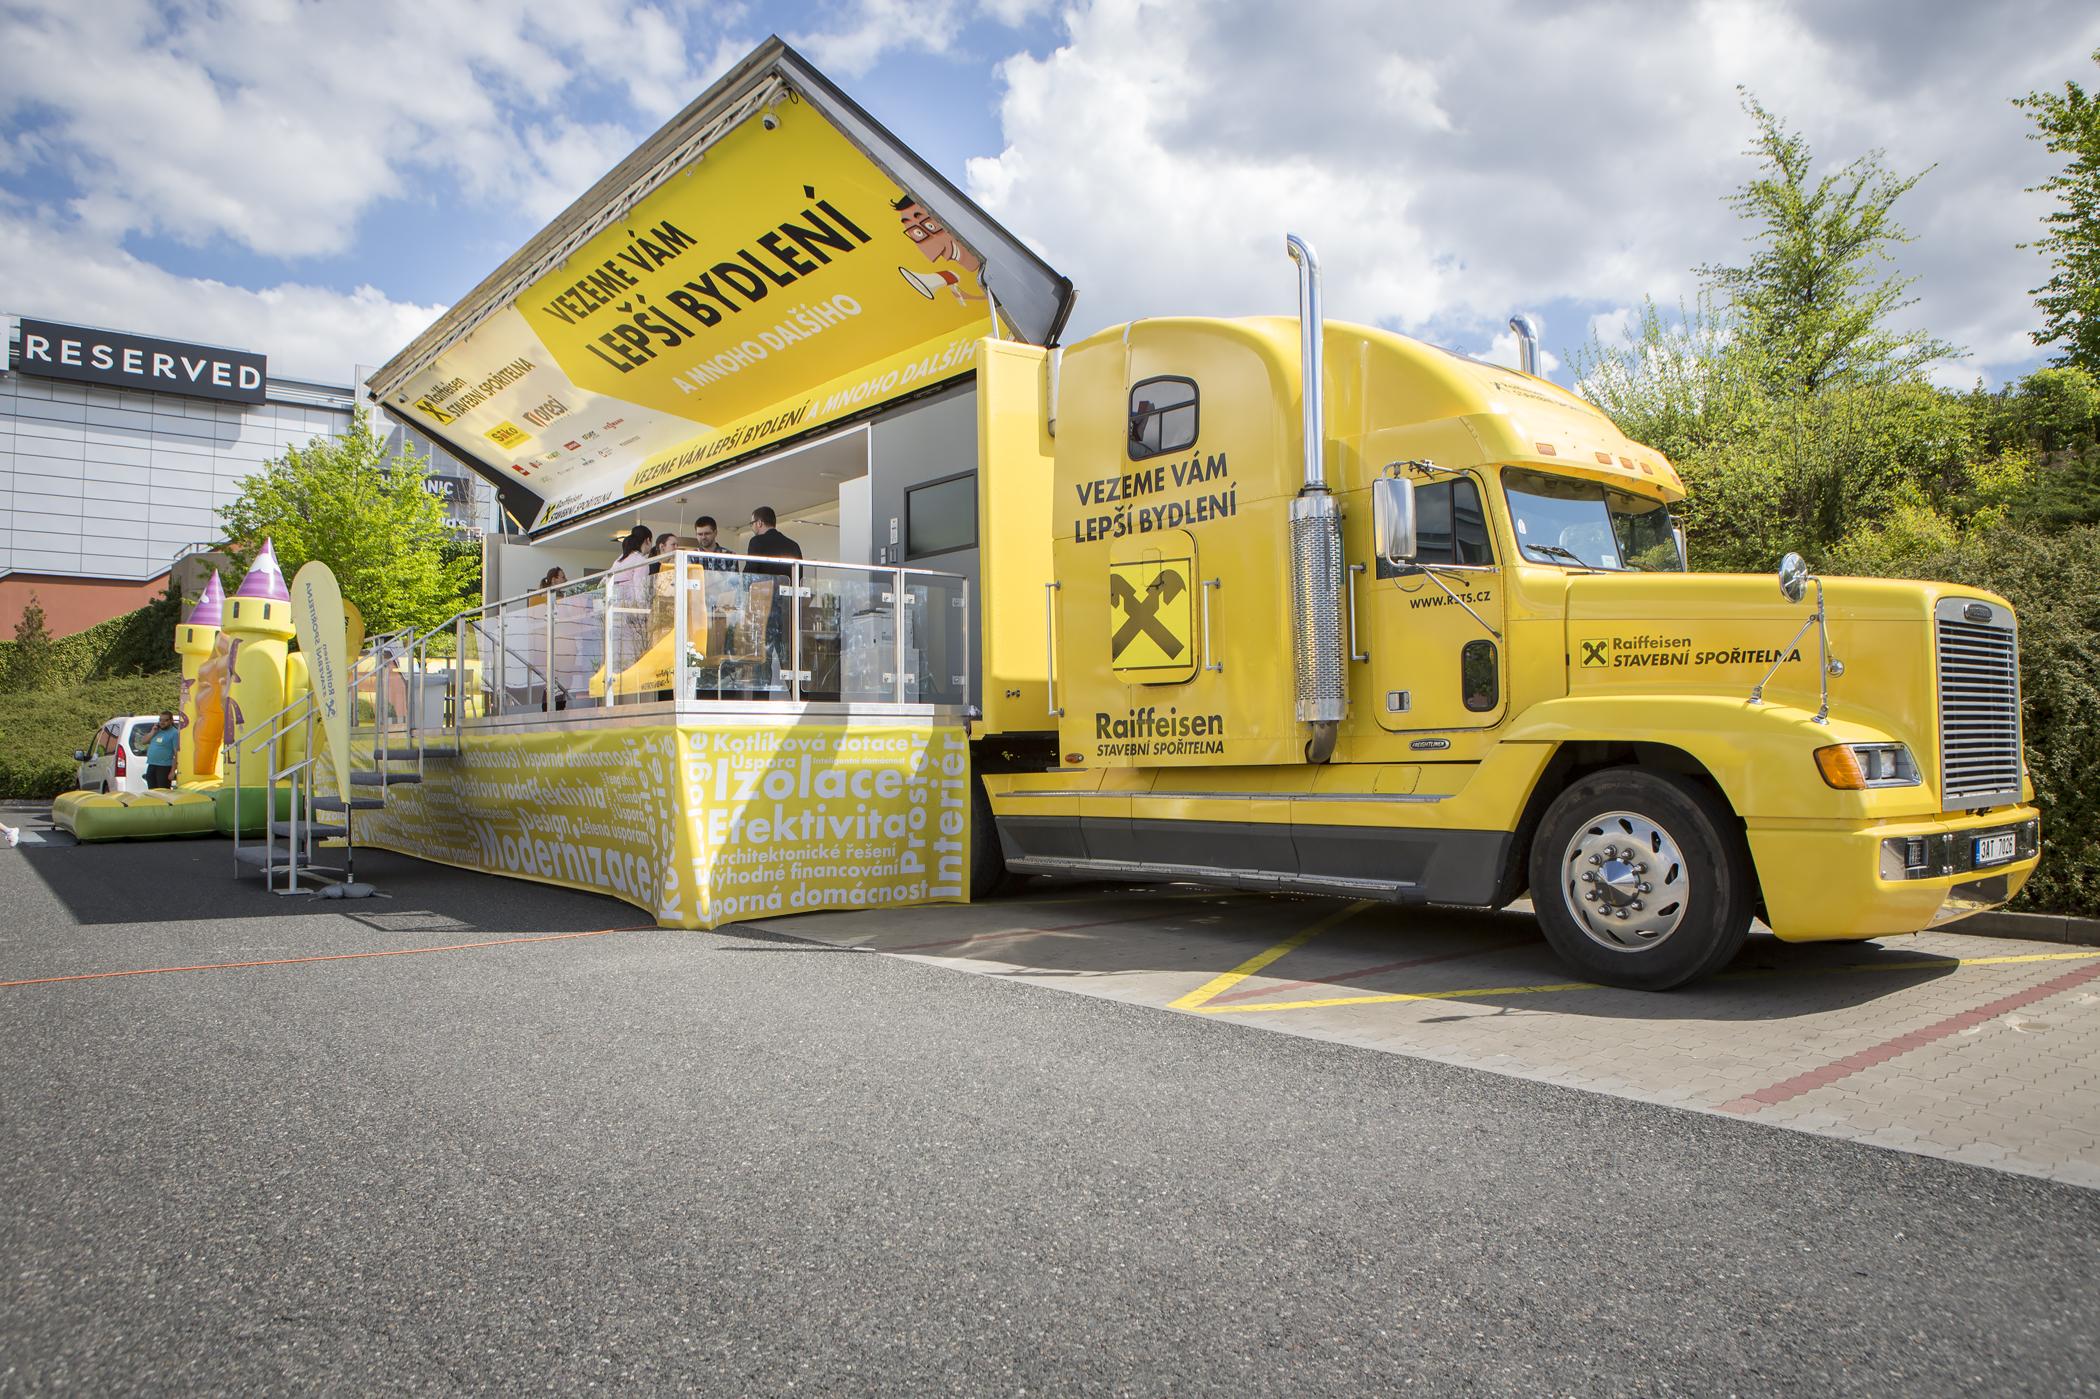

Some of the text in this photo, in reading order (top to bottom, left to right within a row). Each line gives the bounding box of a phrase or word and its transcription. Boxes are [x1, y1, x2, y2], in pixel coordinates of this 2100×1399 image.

[542, 220, 698, 325] VEZEME VÁM
[585, 182, 872, 374] LEPŠÍ BYDLENÍ
[26, 334, 261, 390] RESERVED
[672, 294, 862, 395] A MNOHO DALŠÍHO
[633, 337, 977, 487] VEZEME VÁM LEPŠÍ BYDLENÍ A MNOHO DALŠÍH
[1076, 450, 1228, 506] VEZEME VÁM
[1075, 481, 1237, 543] LEPŠÍ BYDLENÍ
[1613, 635, 1692, 650] Raiffeisen
[1613, 649, 1690, 667] STAVEBNÍ
[713, 731, 908, 753] Kotlíková dotace
[1095, 706, 1223, 739] Raiffeisen
[1097, 738, 1224, 756] STAVEBNÍ SPOŘITELNA
[715, 754, 900, 801] Izolace
[708, 803, 906, 845] Efektivita
[900, 733, 929, 874] Prostor
[929, 733, 965, 897] Interiér
[475, 820, 651, 903] Modernizace
[710, 842, 896, 867] Architektonické řešení
[790, 858, 898, 880] financování
[790, 879, 928, 908] domácnost
